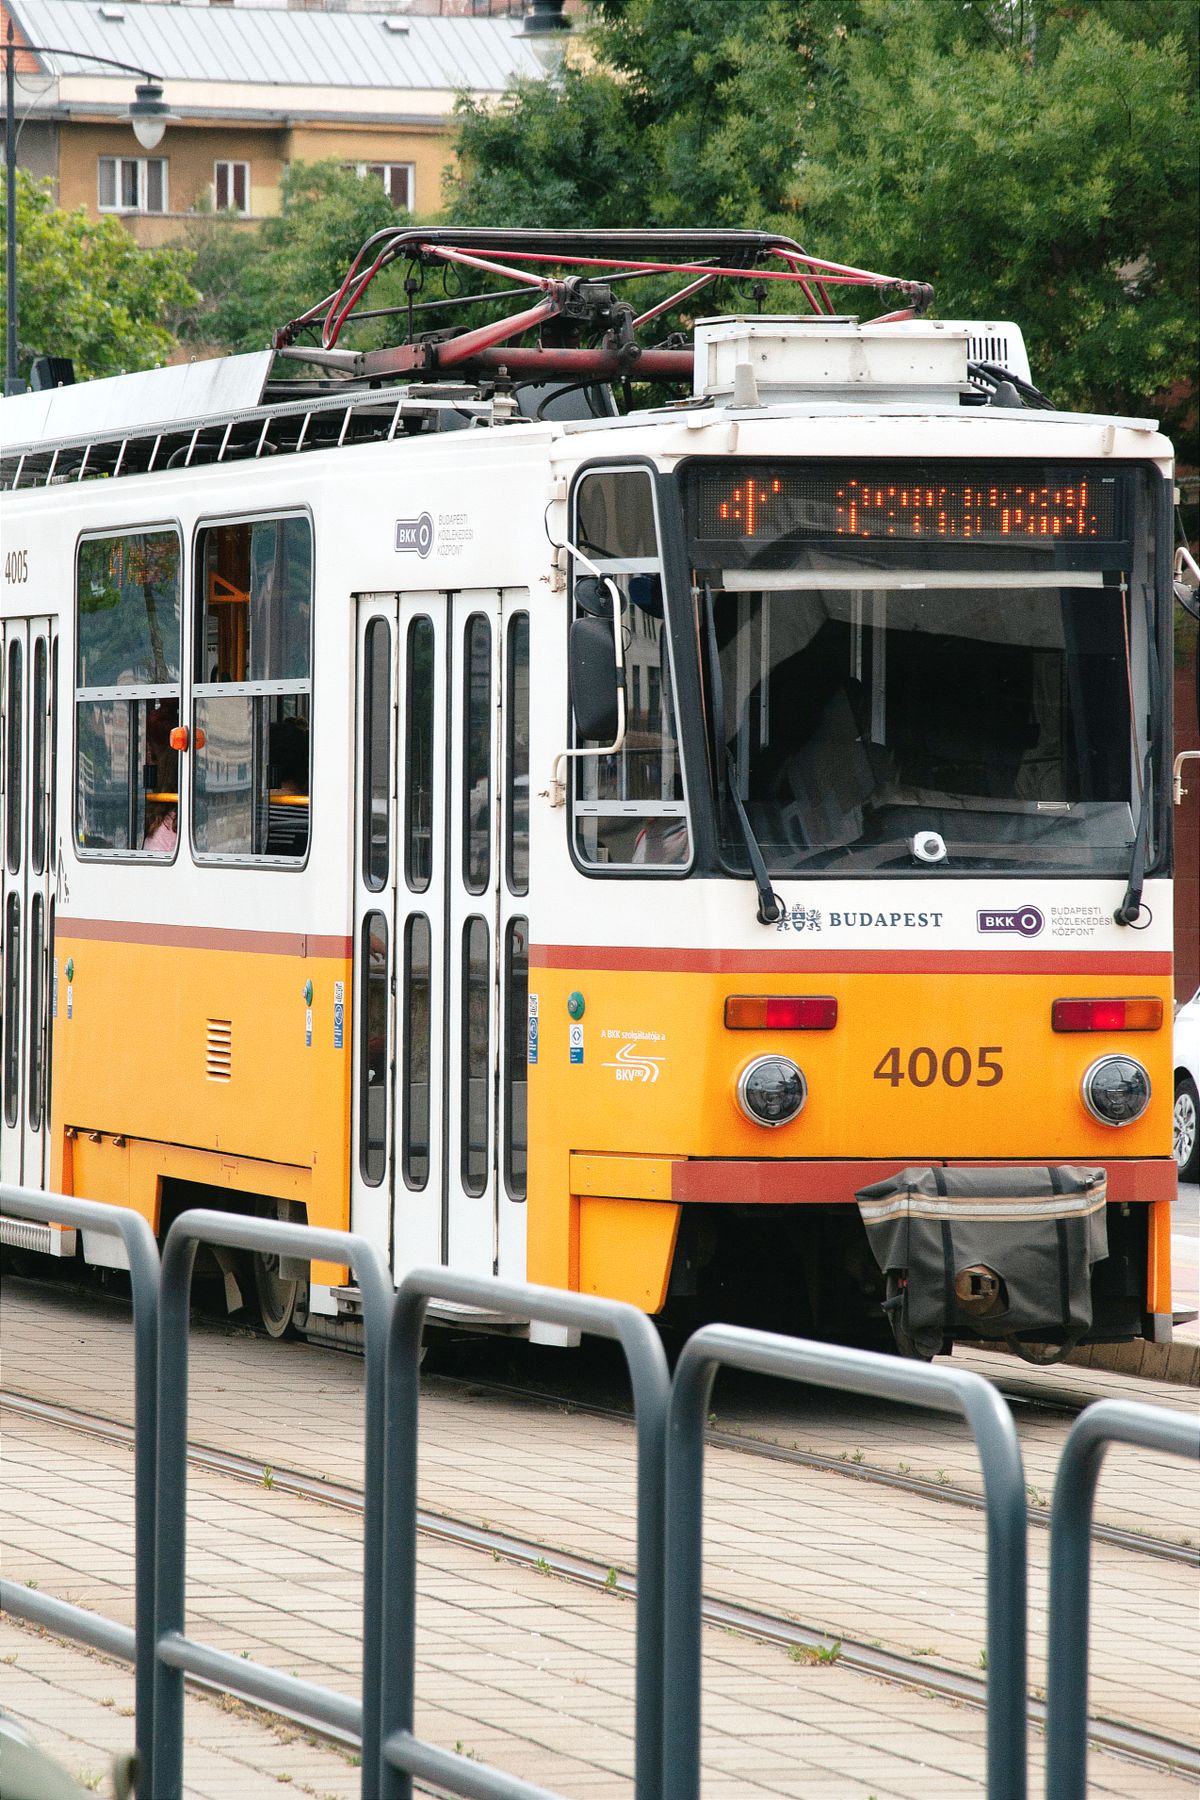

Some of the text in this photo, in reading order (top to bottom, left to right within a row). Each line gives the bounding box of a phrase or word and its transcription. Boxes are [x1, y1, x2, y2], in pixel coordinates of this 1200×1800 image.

[5, 549, 28, 584] 4005
[1051, 906, 1102, 916] BUDAPESTI
[829, 911, 943, 928] BUDAPEST
[985, 916, 1015, 927] BKK
[1051, 915, 1113, 926] KÖZLEKEDÉSI
[1051, 926, 1096, 936] KÖZPONT
[601, 1029, 607, 1038] A
[607, 1030, 620, 1039] BKK
[873, 1046, 1004, 1088] 4005
[615, 1068, 634, 1082] BKV
